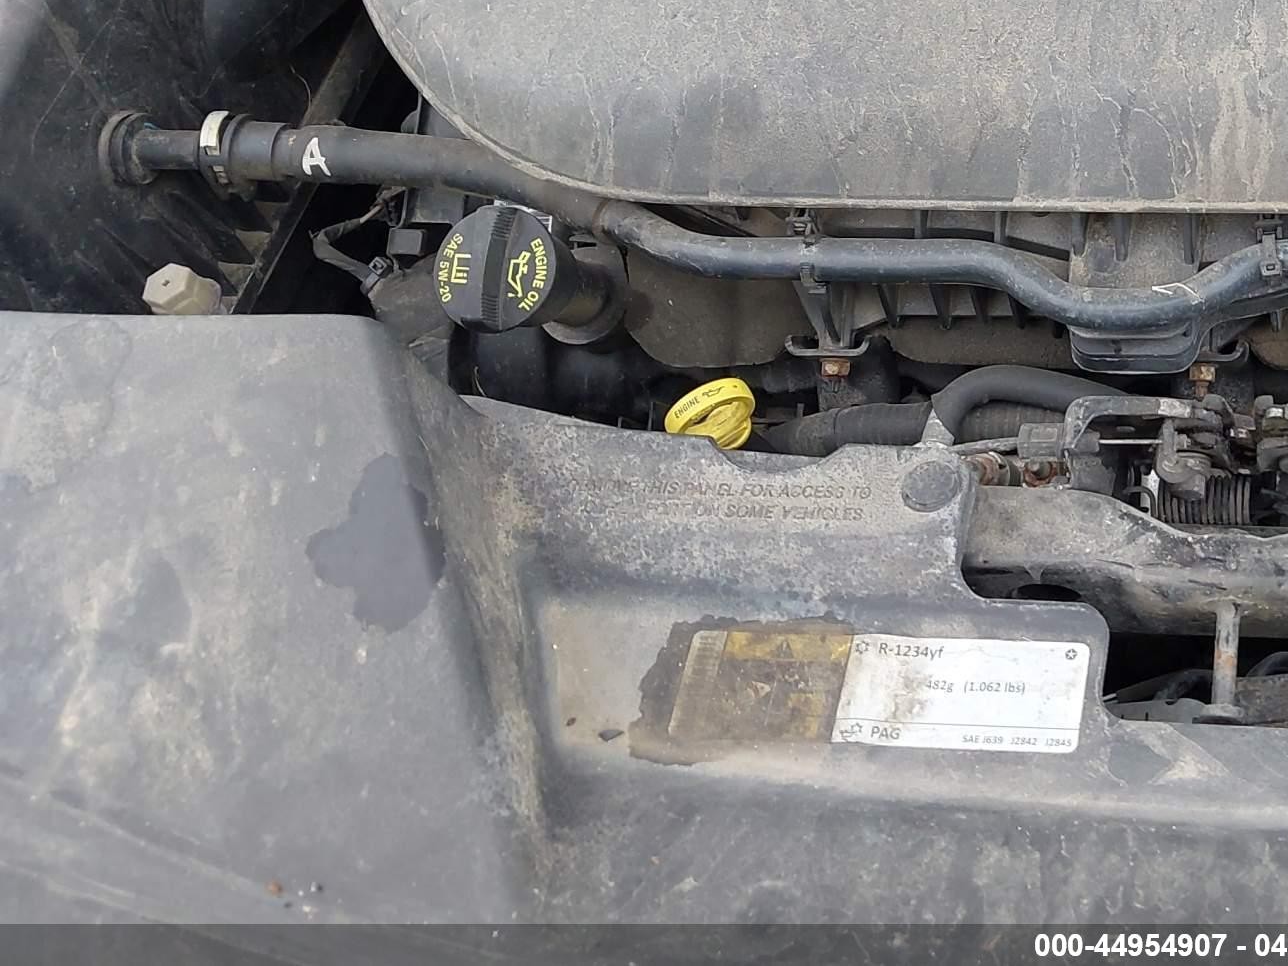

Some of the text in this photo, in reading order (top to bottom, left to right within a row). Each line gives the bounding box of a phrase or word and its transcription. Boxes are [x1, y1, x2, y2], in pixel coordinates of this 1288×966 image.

[302, 137, 331, 176] A
[438, 234, 463, 303] SAE 5W-20
[518, 238, 547, 311] ENGINE OIL
[673, 396, 701, 419] ENGINE
[683, 481, 734, 495] PANEL
[739, 481, 775, 495] FOR
[778, 482, 845, 497] ACCESS
[853, 483, 872, 497] TO
[724, 503, 778, 519] SOME
[781, 505, 864, 522] VEHICLES
[878, 642, 945, 661] R-1234yf
[963, 681, 1001, 694] (1.062
[1004, 682, 1026, 695] lbs)
[870, 726, 902, 740] PAG
[961, 734, 980, 744] SAE
[982, 735, 1004, 745] J639
[1010, 736, 1038, 746] J2842
